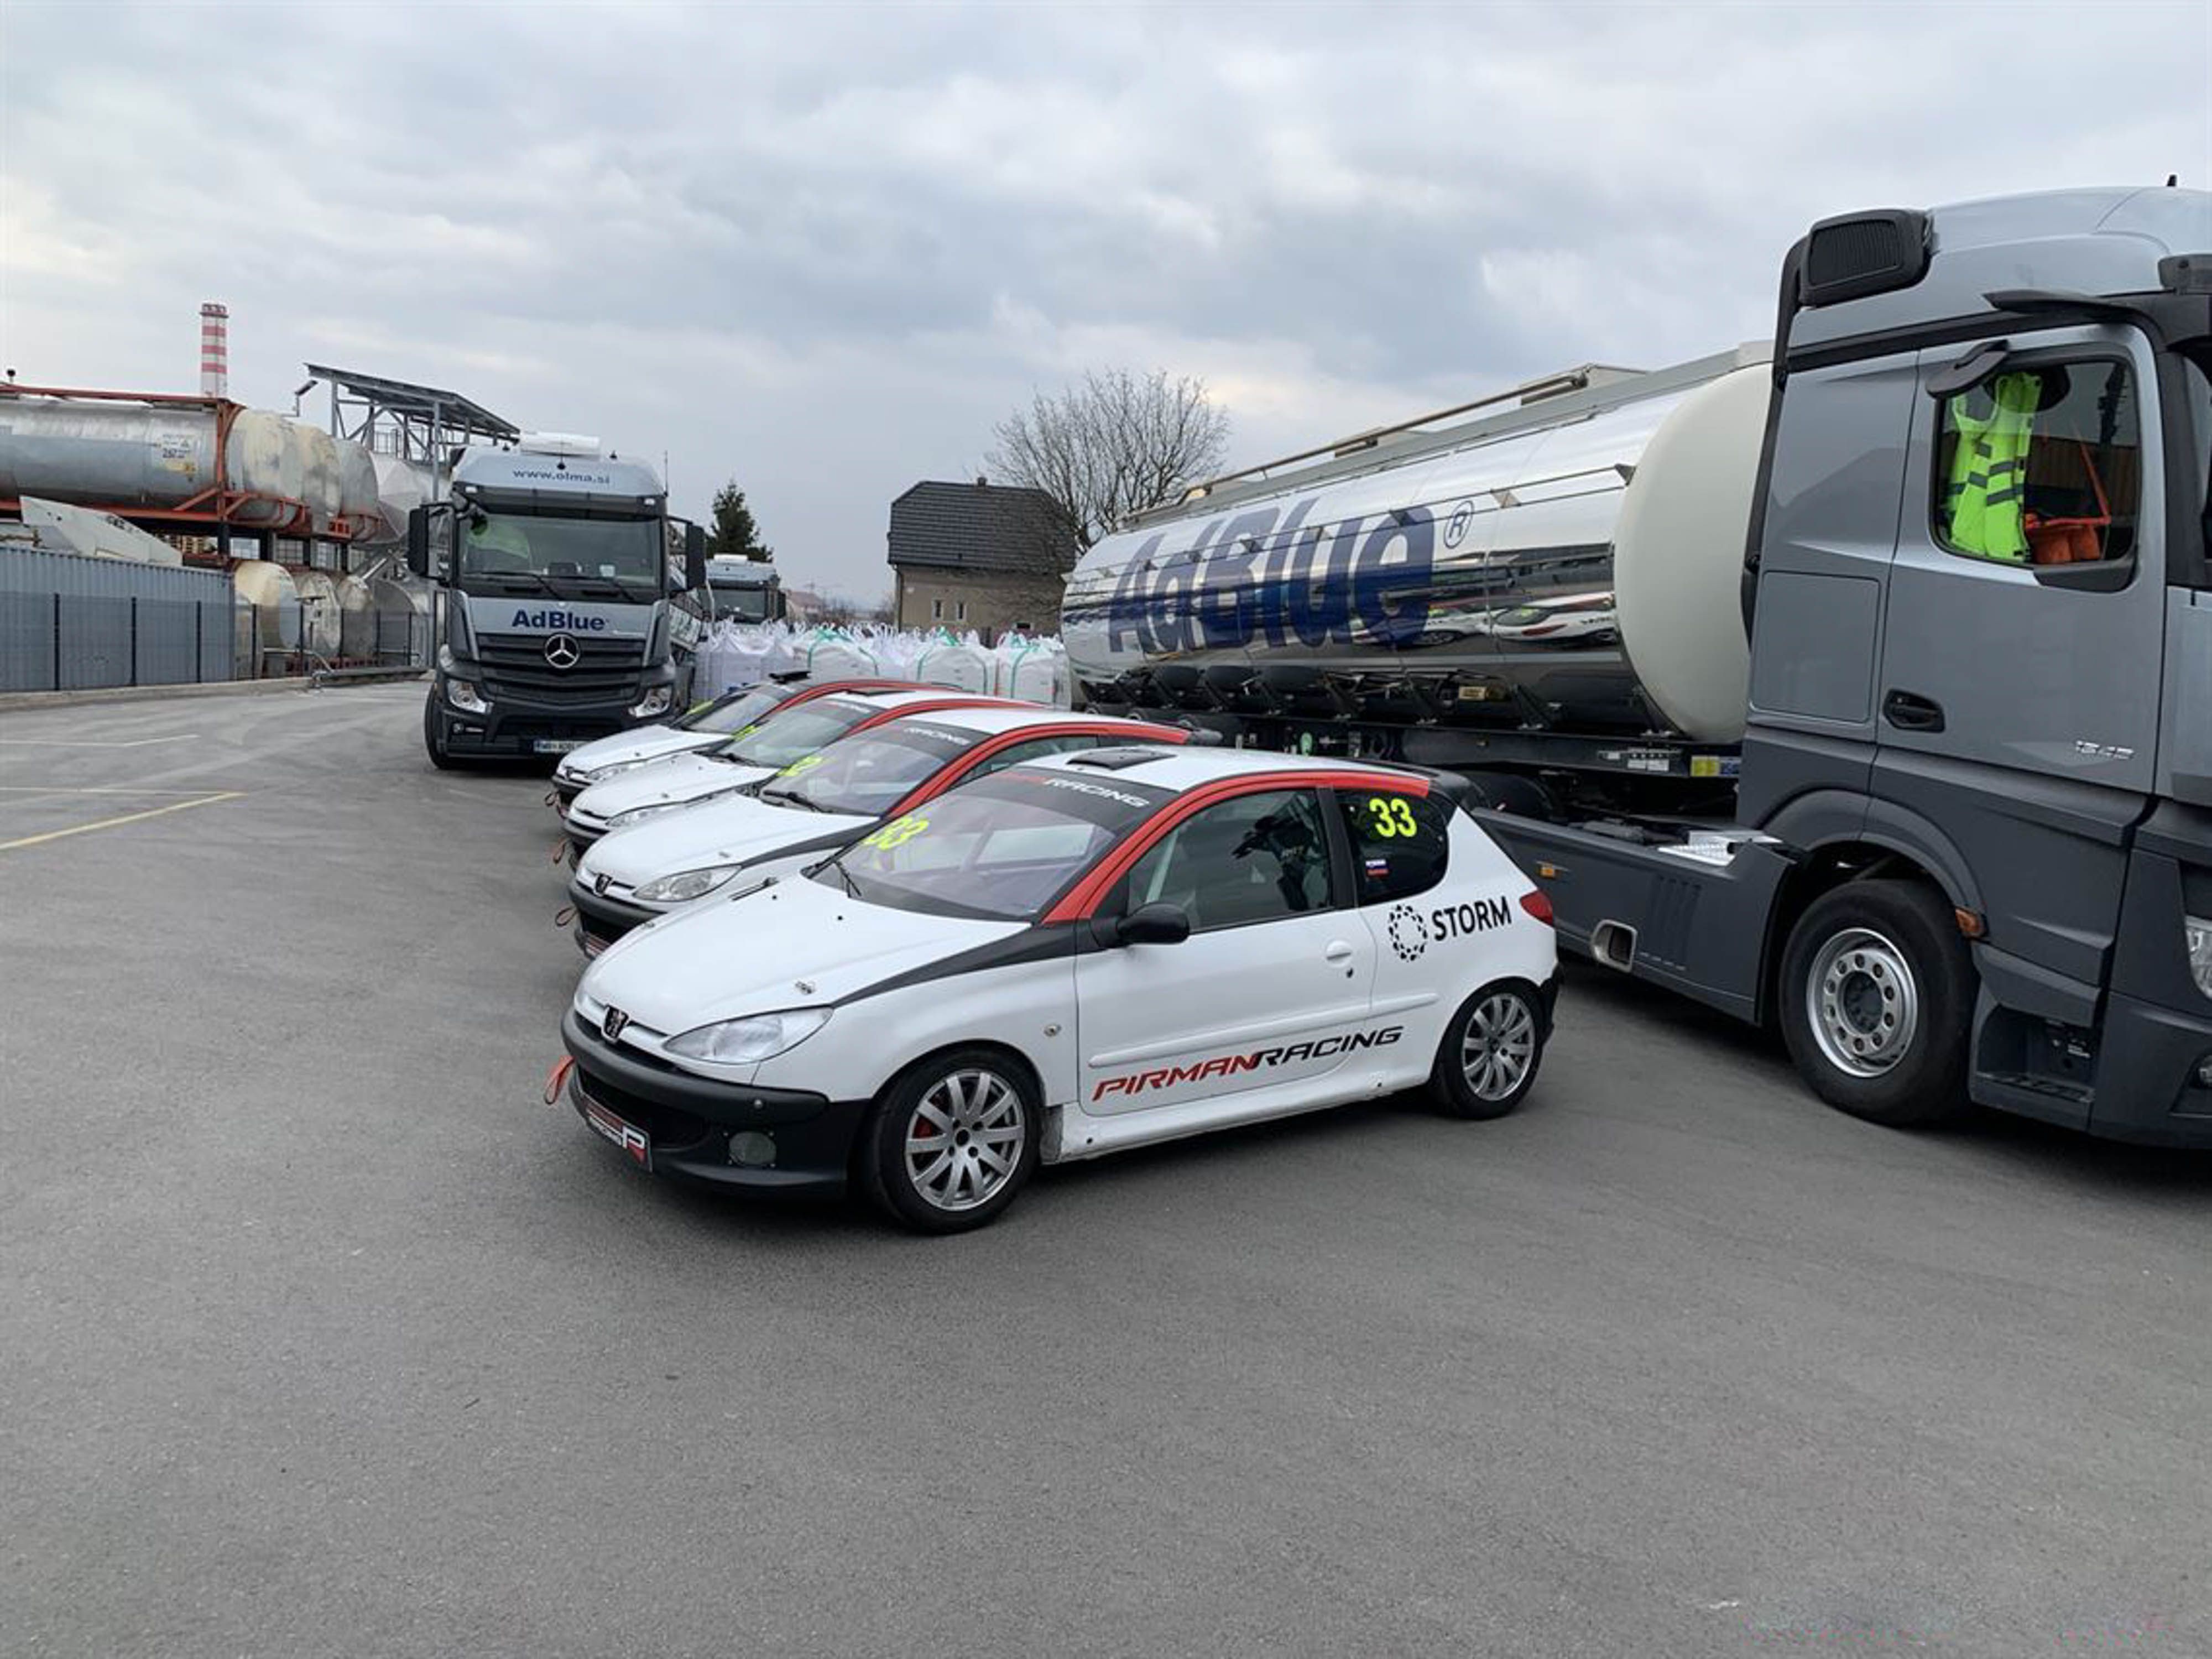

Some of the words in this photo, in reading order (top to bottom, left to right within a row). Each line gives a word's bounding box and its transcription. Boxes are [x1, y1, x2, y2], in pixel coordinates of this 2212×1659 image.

[513, 470, 610, 484] www.olma.si
[1109, 497, 1435, 653] AdBlue
[512, 609, 605, 631] AdBlue
[1369, 798, 1417, 837] 33
[1432, 895, 1512, 942] STORM
